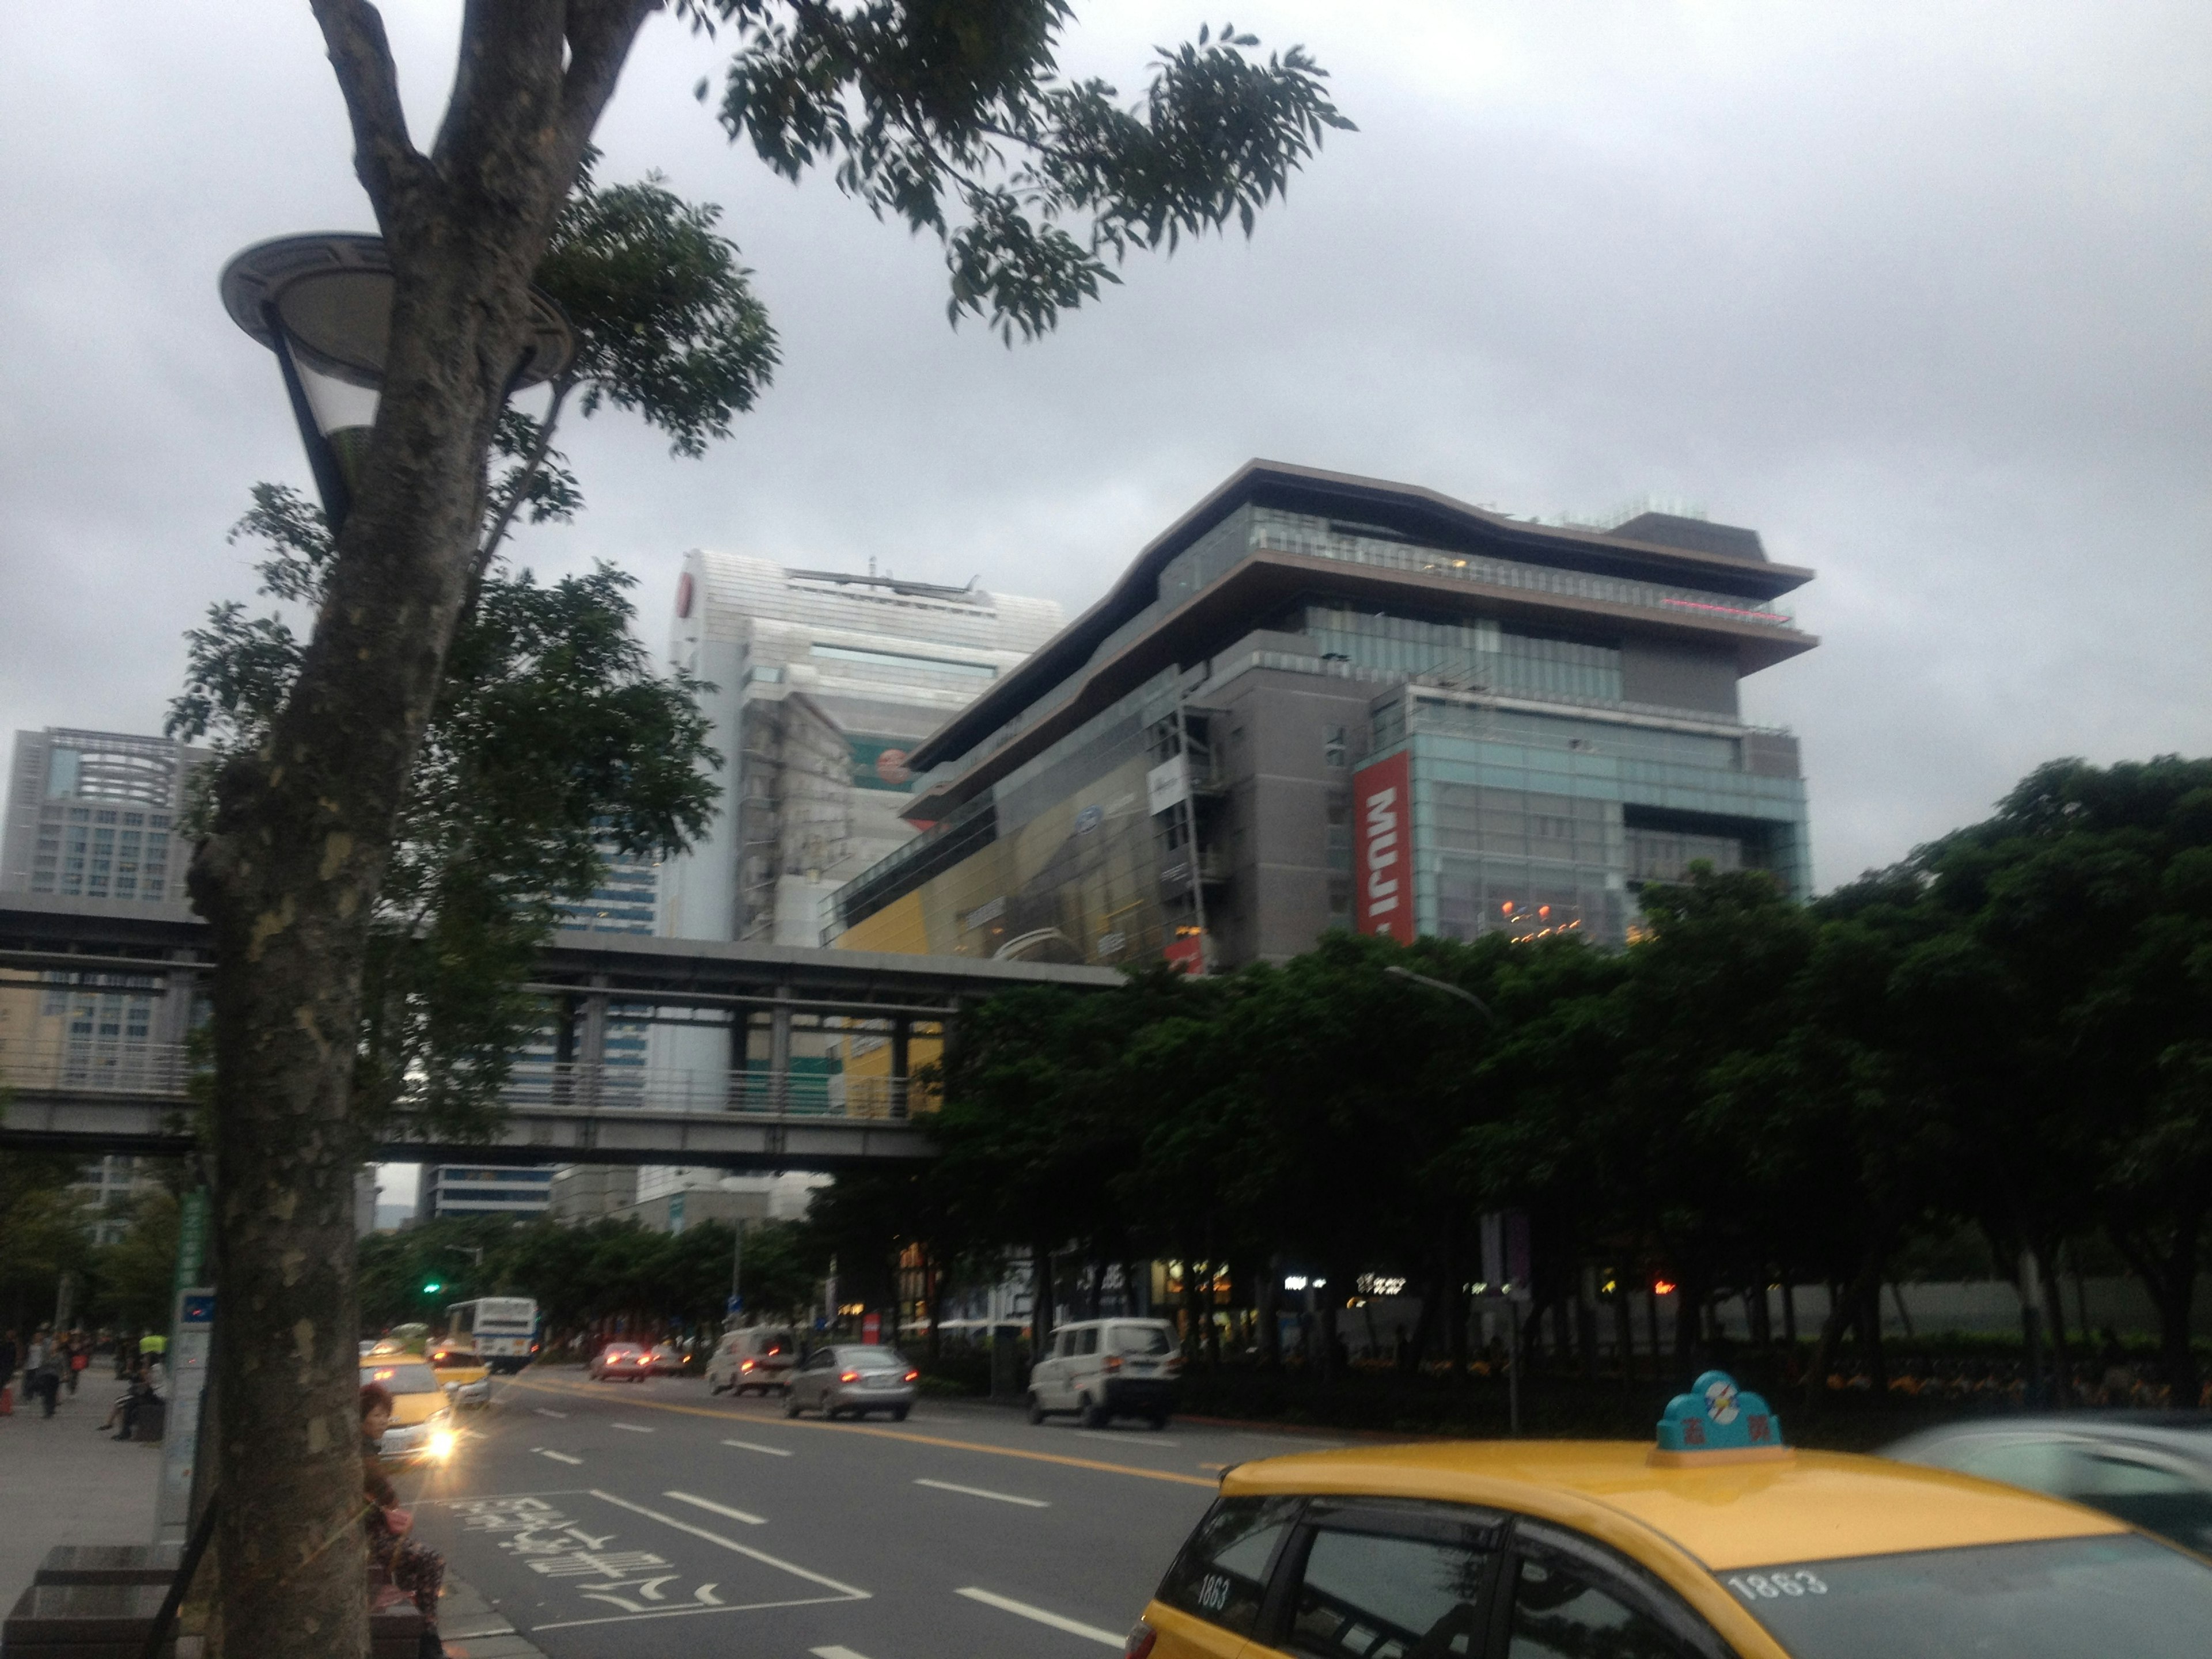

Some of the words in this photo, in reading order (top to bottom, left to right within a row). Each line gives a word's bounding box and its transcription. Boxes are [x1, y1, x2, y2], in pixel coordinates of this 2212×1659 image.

[1366, 786, 1399, 918] MUJI
[1198, 1573, 1230, 1611] 1863
[1729, 1570, 1828, 1600] 1863
